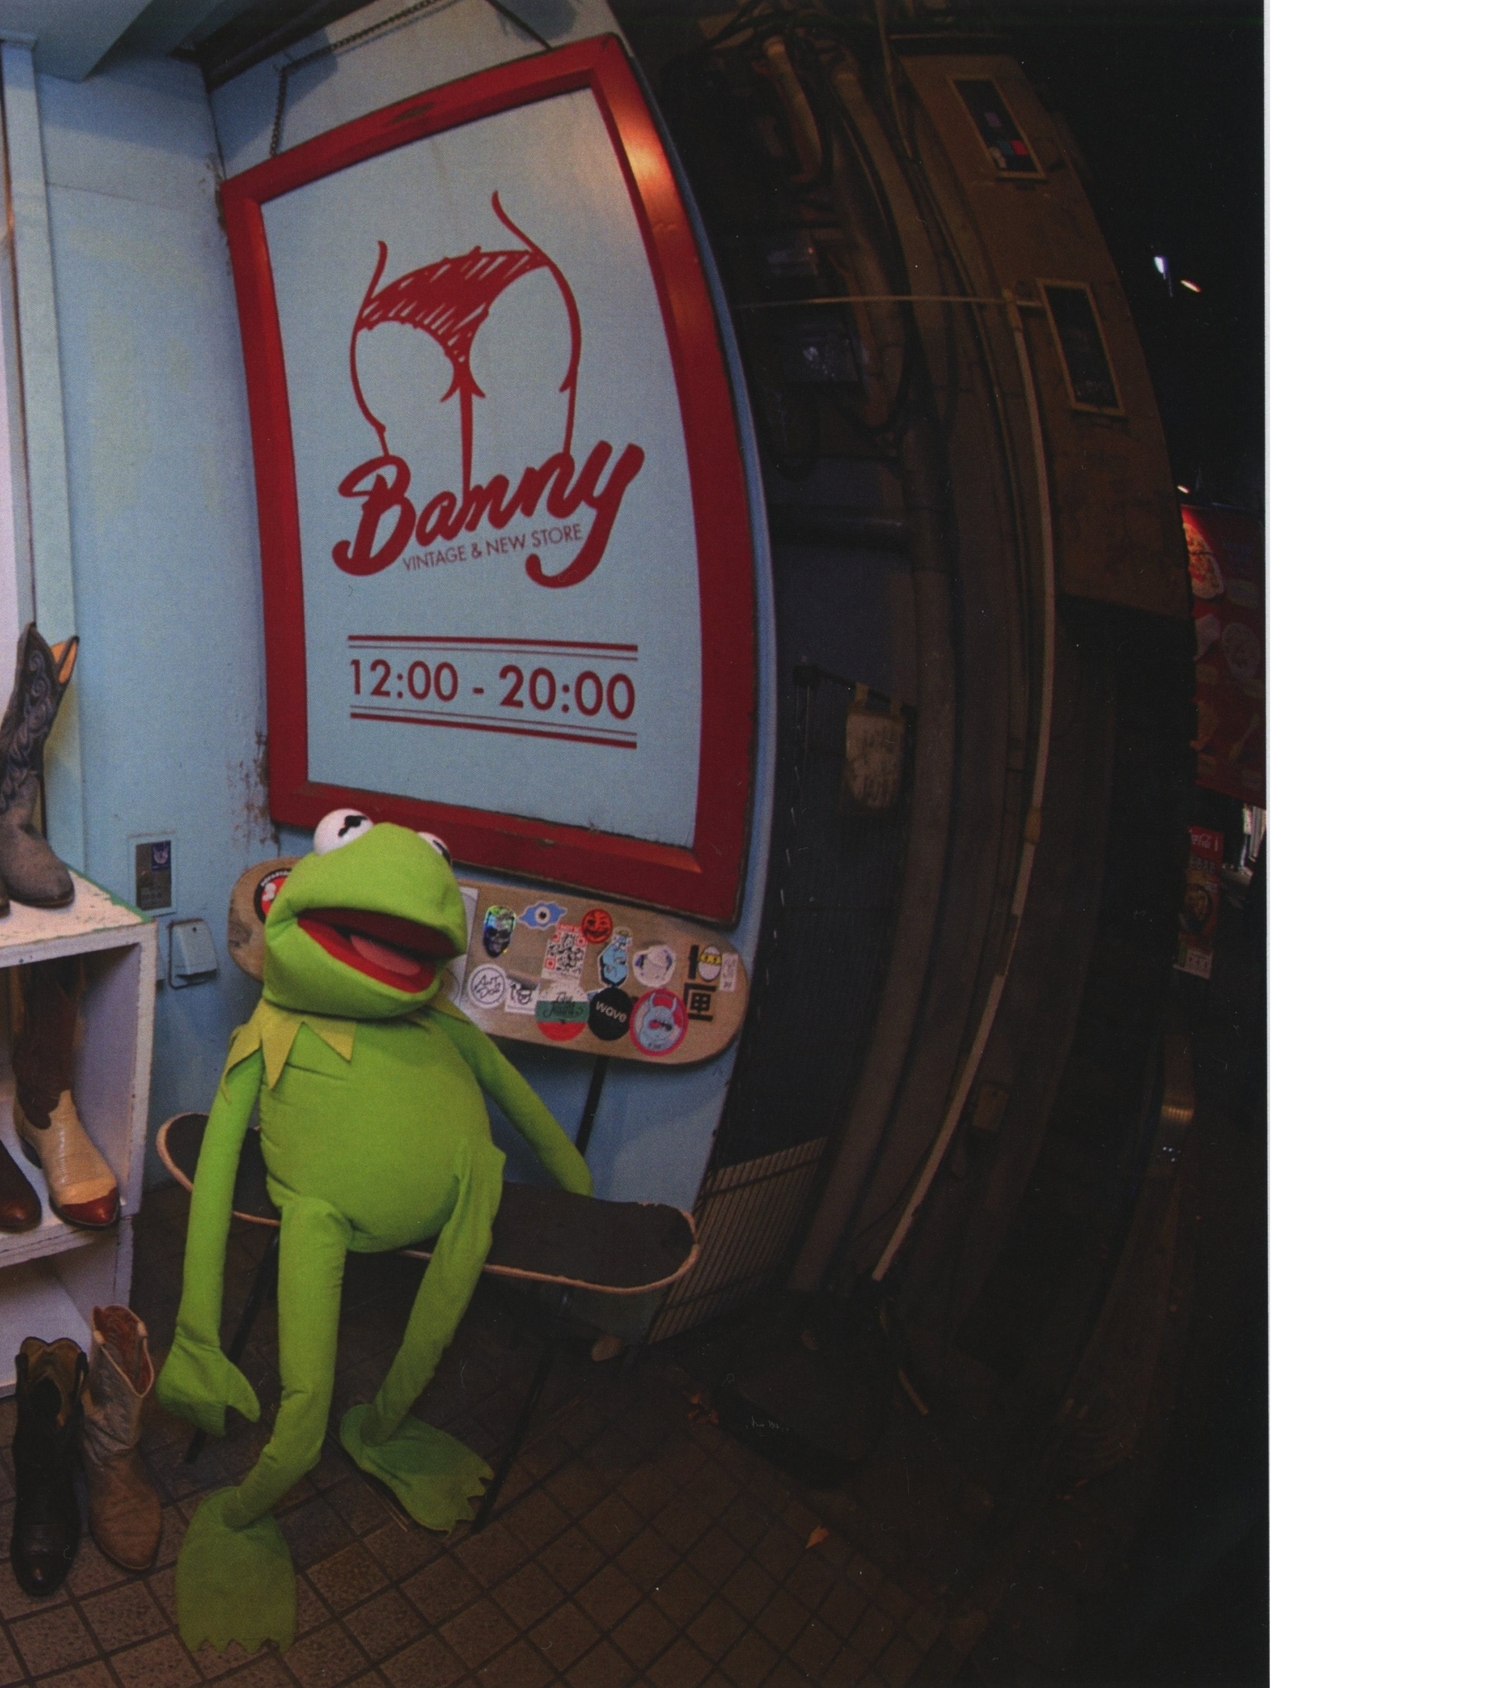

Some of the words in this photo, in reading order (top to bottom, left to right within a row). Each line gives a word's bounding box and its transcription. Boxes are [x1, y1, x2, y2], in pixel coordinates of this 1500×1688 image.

[332, 440, 645, 588] Banny
[403, 545, 467, 571] VINTAGE
[471, 543, 482, 559] &
[485, 534, 526, 556] NEW
[530, 523, 583, 548] STORE
[350, 659, 459, 701] 12:00
[499, 664, 636, 720] 20:00
[595, 1000, 628, 1023] wave
